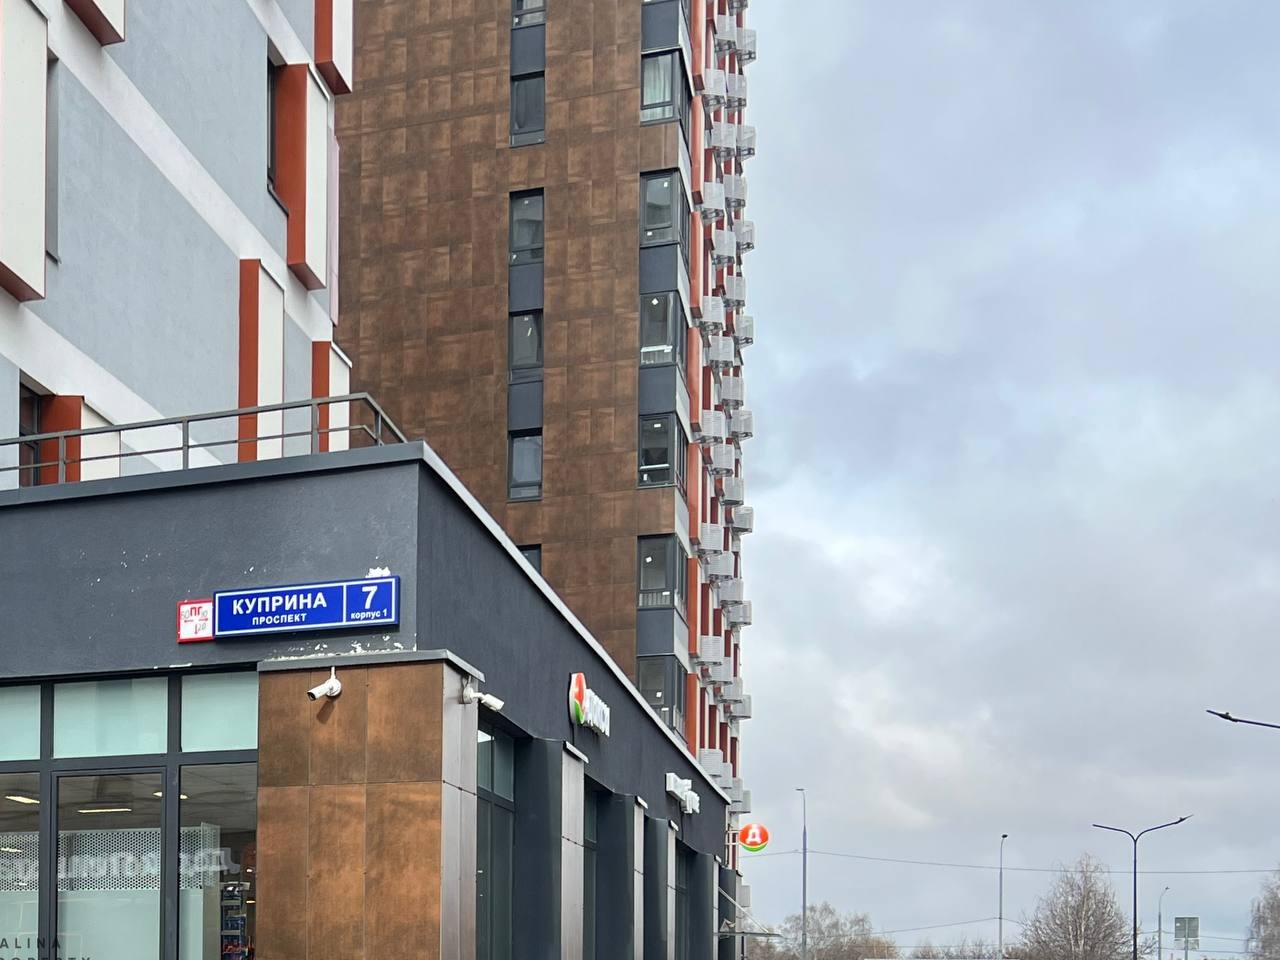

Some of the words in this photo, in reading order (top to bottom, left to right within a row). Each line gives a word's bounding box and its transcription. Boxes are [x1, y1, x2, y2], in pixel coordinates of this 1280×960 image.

[232, 592, 327, 615] КУПРИНА
[361, 585, 378, 610] 7
[252, 612, 307, 626] ПРОСПЕКТ
[350, 613, 381, 622] корпус
